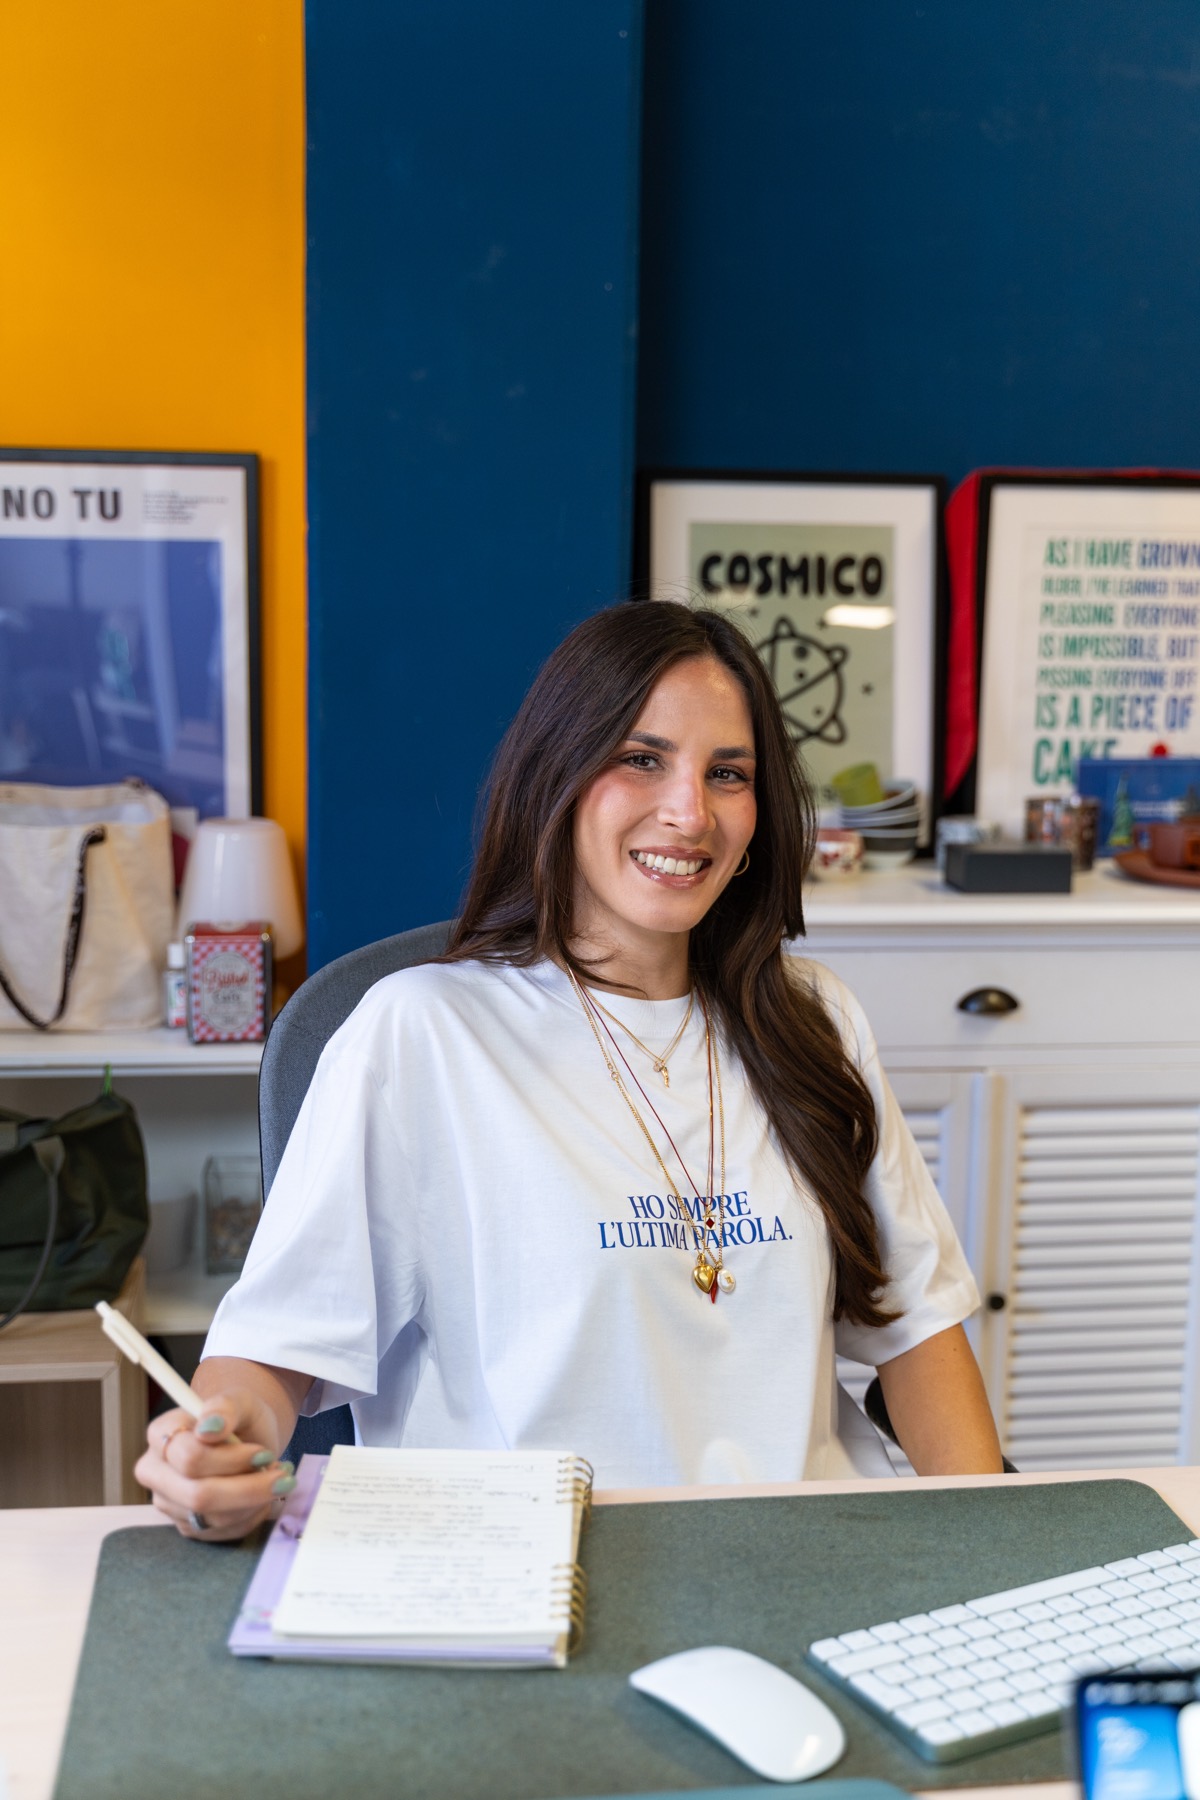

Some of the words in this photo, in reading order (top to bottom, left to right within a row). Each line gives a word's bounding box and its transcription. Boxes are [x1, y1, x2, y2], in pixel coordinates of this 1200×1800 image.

[2, 487, 55, 519] NO
[72, 488, 121, 521] TU
[1044, 539, 1067, 568] AS
[1073, 540, 1081, 568] I
[1085, 540, 1132, 569] HAVE
[1138, 541, 1200, 569] GROWN
[701, 554, 884, 597] COSMICO
[1040, 603, 1114, 627] PLEASING
[1124, 604, 1198, 628] EVERYONE
[1039, 634, 1054, 658] IS
[1168, 636, 1199, 659] BUT
[1037, 668, 1092, 688] PISSING
[1096, 669, 1165, 689] EVERYONE
[1036, 694, 1057, 728] IS
[1066, 695, 1081, 728] A
[1091, 695, 1156, 730] PIECE
[1166, 695, 1193, 730] OF
[628, 1195, 665, 1219] HO
[667, 1191, 751, 1222] SEMPRE
[598, 1222, 689, 1250] L'ULTIMA
[681, 1216, 793, 1250] PAROLA.
